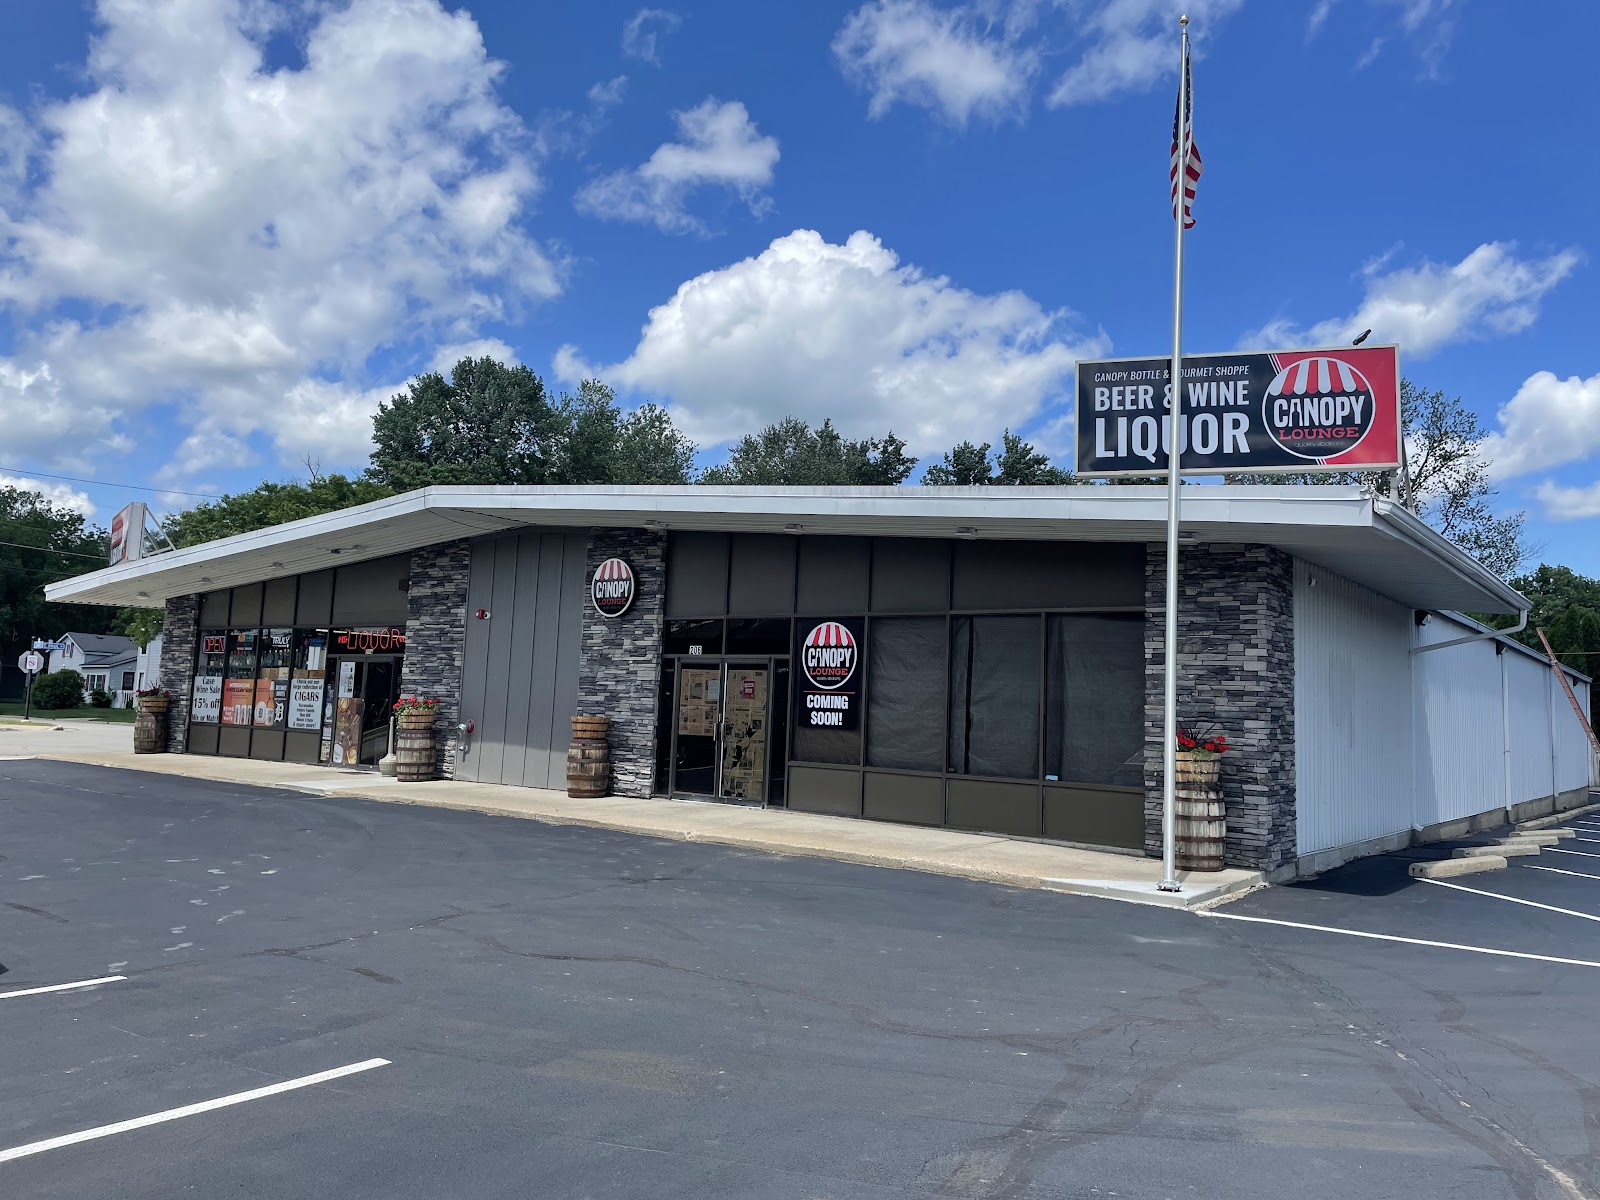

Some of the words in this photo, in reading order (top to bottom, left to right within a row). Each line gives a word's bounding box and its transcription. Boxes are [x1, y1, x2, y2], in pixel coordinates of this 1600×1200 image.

[1094, 371, 1128, 383] CANOPY
[1130, 369, 1161, 380] BOTTLE
[1163, 369, 1170, 379] &
[1215, 365, 1250, 376] SHOPPE
[1094, 385, 1154, 411] BEER
[1187, 380, 1250, 408] WINE
[1273, 395, 1366, 428] CANOPY
[1095, 412, 1251, 463] LIQUOR
[1279, 427, 1360, 440] LOUNGE
[595, 580, 630, 599] CANOPY
[598, 597, 627, 606] LOUNGE
[203, 637, 225, 652] OPEN
[272, 635, 291, 645] TRULY
[807, 647, 853, 668] CANOPY
[809, 667, 849, 676] LOUNGE
[202, 677, 215, 685] Case
[195, 685, 209, 694] Wine
[210, 685, 221, 694] Sale
[294, 691, 320, 702] CIGARS
[194, 697, 209, 709] 15%
[210, 698, 221, 709] off
[806, 694, 849, 709] COMING
[810, 710, 843, 726] SOON!
